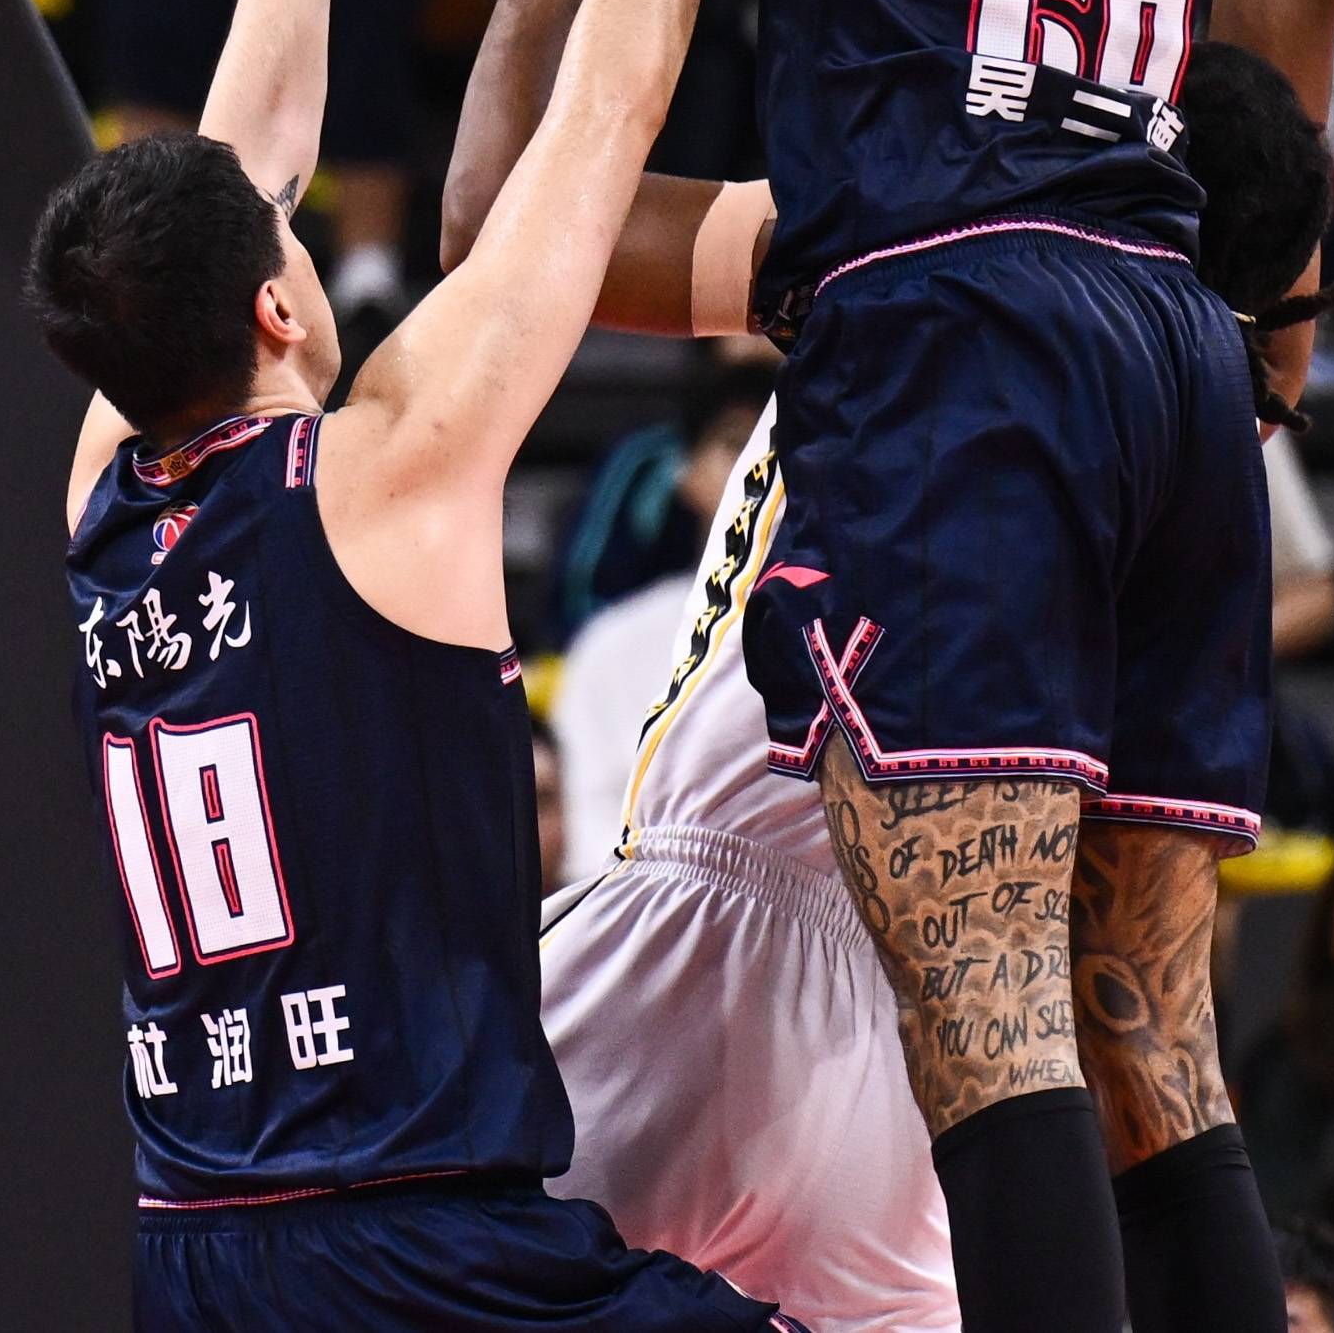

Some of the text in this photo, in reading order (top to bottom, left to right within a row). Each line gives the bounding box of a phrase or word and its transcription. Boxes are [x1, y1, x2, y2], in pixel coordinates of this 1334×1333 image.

[103, 712, 294, 979] 18
[889, 834, 923, 879] OF
[937, 824, 1018, 889] DEATH
[923, 892, 988, 948] OUT
[991, 881, 1042, 915] OF
[921, 956, 991, 1002] BUT
[989, 952, 1010, 993] A
[126, 984, 355, 1099] 杜润旺
[936, 1016, 975, 1059] YOU
[984, 1006, 1029, 1060] CAN
